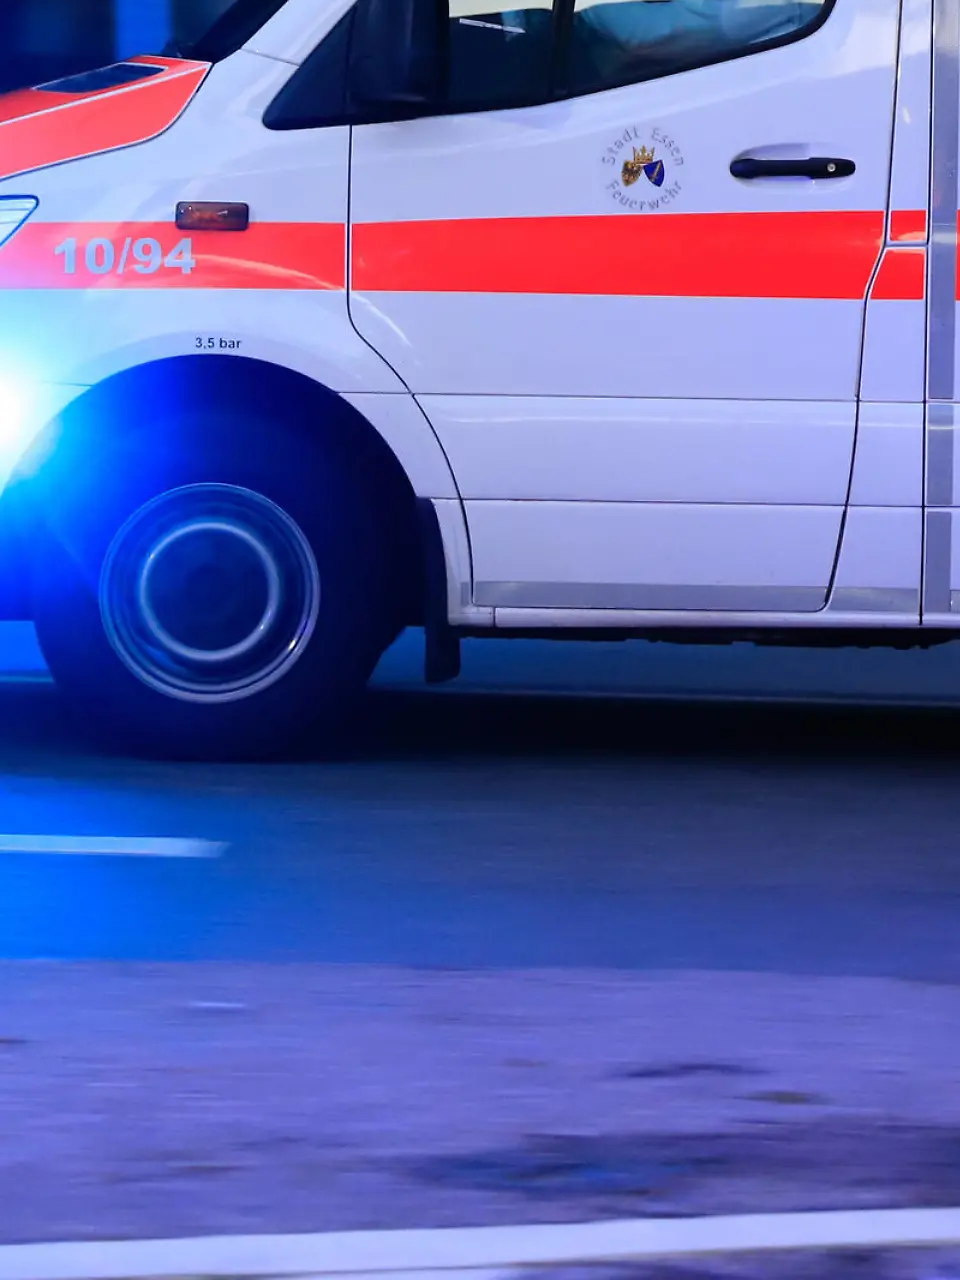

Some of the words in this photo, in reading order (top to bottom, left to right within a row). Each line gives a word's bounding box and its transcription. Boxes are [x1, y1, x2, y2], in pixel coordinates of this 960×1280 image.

[601, 125, 640, 166] Stadt
[651, 127, 684, 166] Essen
[605, 179, 682, 211] Feuerwehr
[54, 237, 196, 274] 10/94
[195, 337, 215, 350] 3,5
[219, 337, 242, 349] bar
